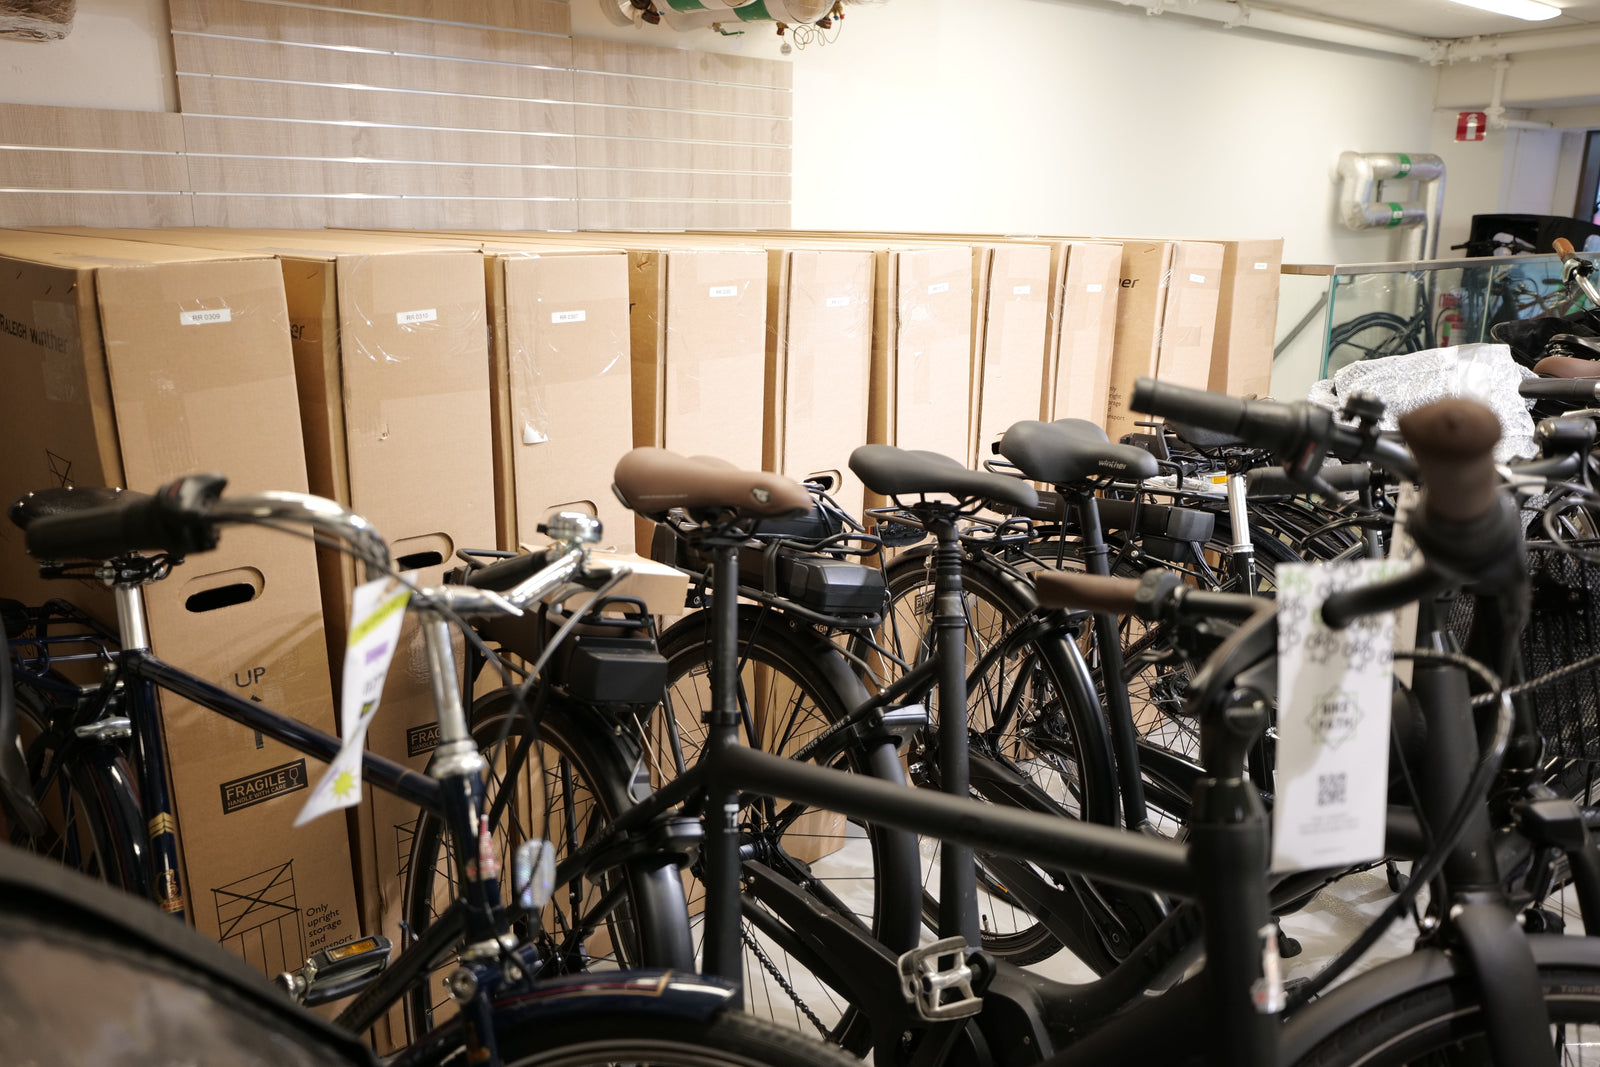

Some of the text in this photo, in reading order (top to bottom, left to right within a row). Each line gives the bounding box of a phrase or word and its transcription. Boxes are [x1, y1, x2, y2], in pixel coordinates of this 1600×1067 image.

[234, 666, 266, 688] UP
[411, 727, 441, 745] FRAG
[226, 771, 287, 801] FRAGILE
[227, 783, 287, 808] HANDLE WITH CARE
[306, 903, 329, 917] Only
[307, 909, 340, 927] upright
[308, 919, 342, 938] storage
[309, 934, 326, 948] and
